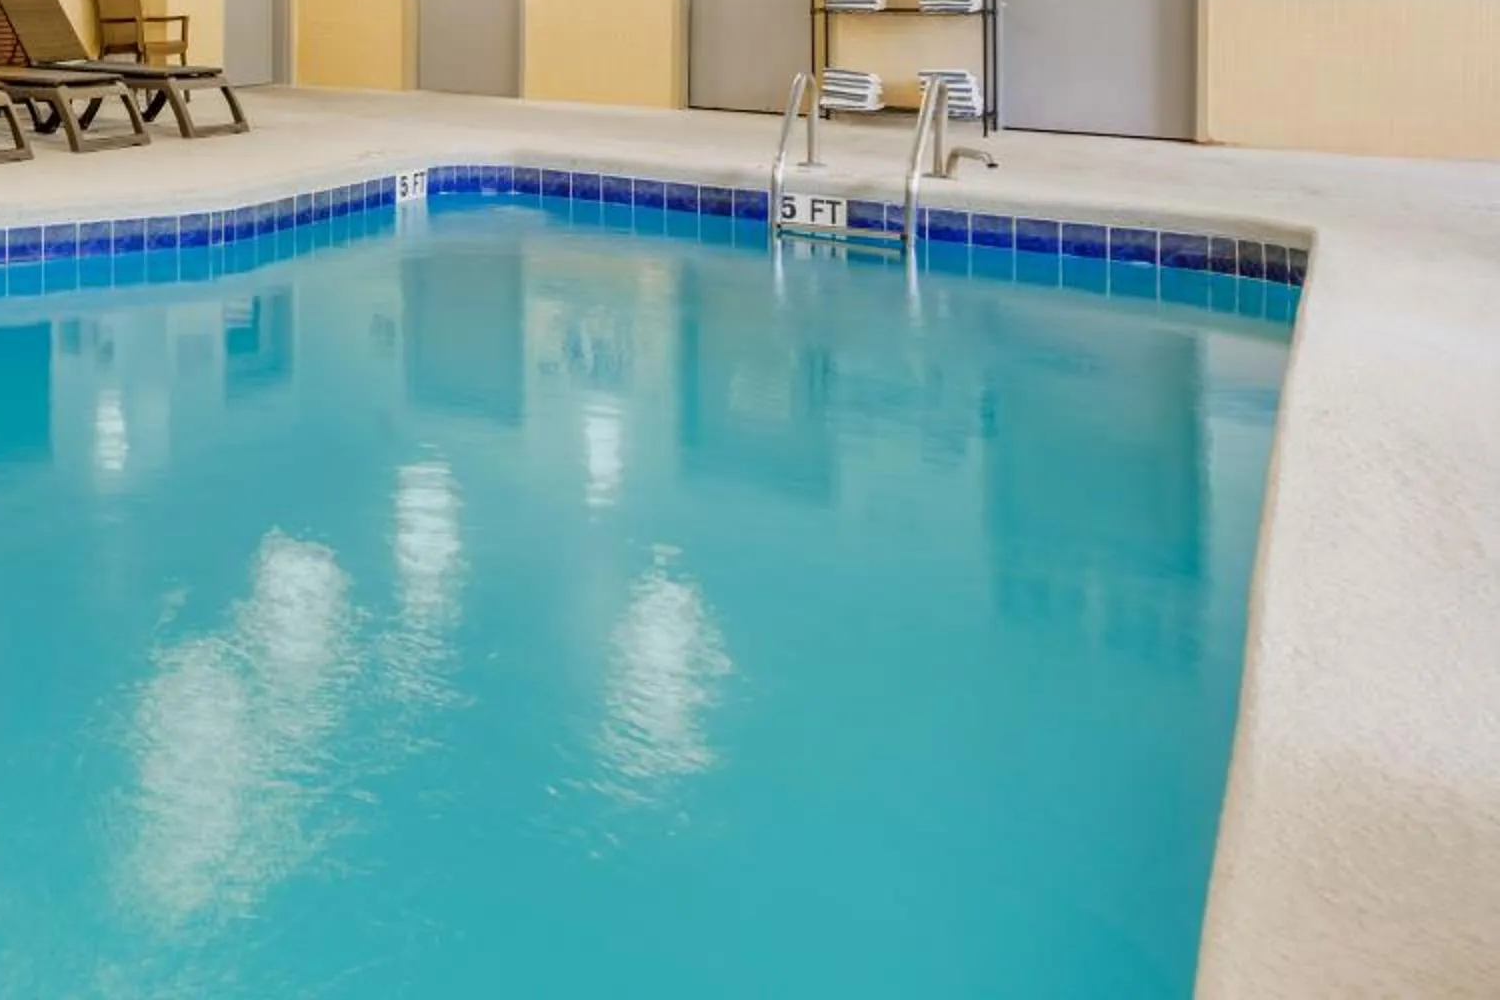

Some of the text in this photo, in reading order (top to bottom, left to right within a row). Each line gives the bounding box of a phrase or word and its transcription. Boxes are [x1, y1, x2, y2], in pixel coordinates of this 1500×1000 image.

[400, 171, 425, 198] 5 FT
[780, 195, 842, 225] 5 FT
